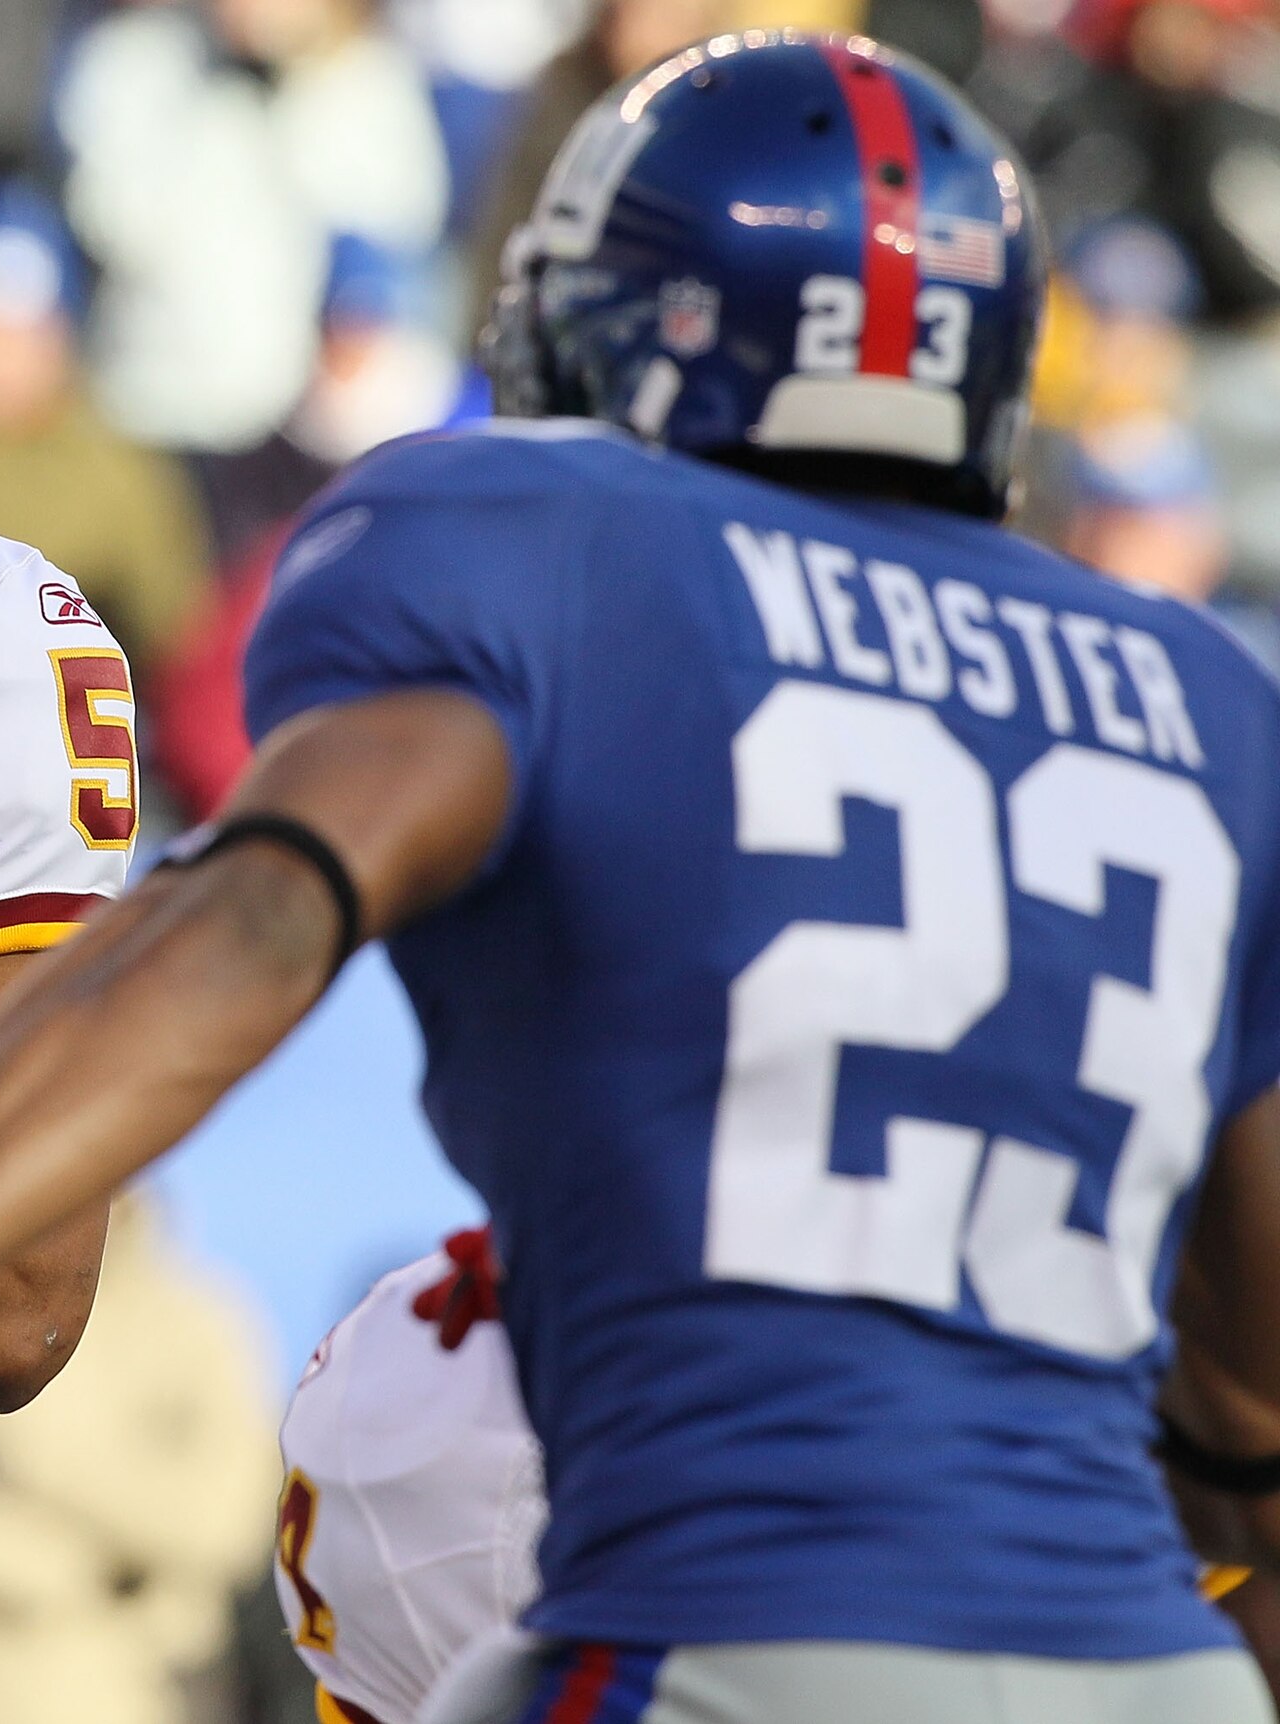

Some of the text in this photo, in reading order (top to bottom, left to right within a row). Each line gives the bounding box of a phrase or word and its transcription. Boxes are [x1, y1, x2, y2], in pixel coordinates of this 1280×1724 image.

[47, 648, 139, 851] 5
[723, 520, 1209, 772] WEBSTER
[704, 680, 1243, 1364] 23
